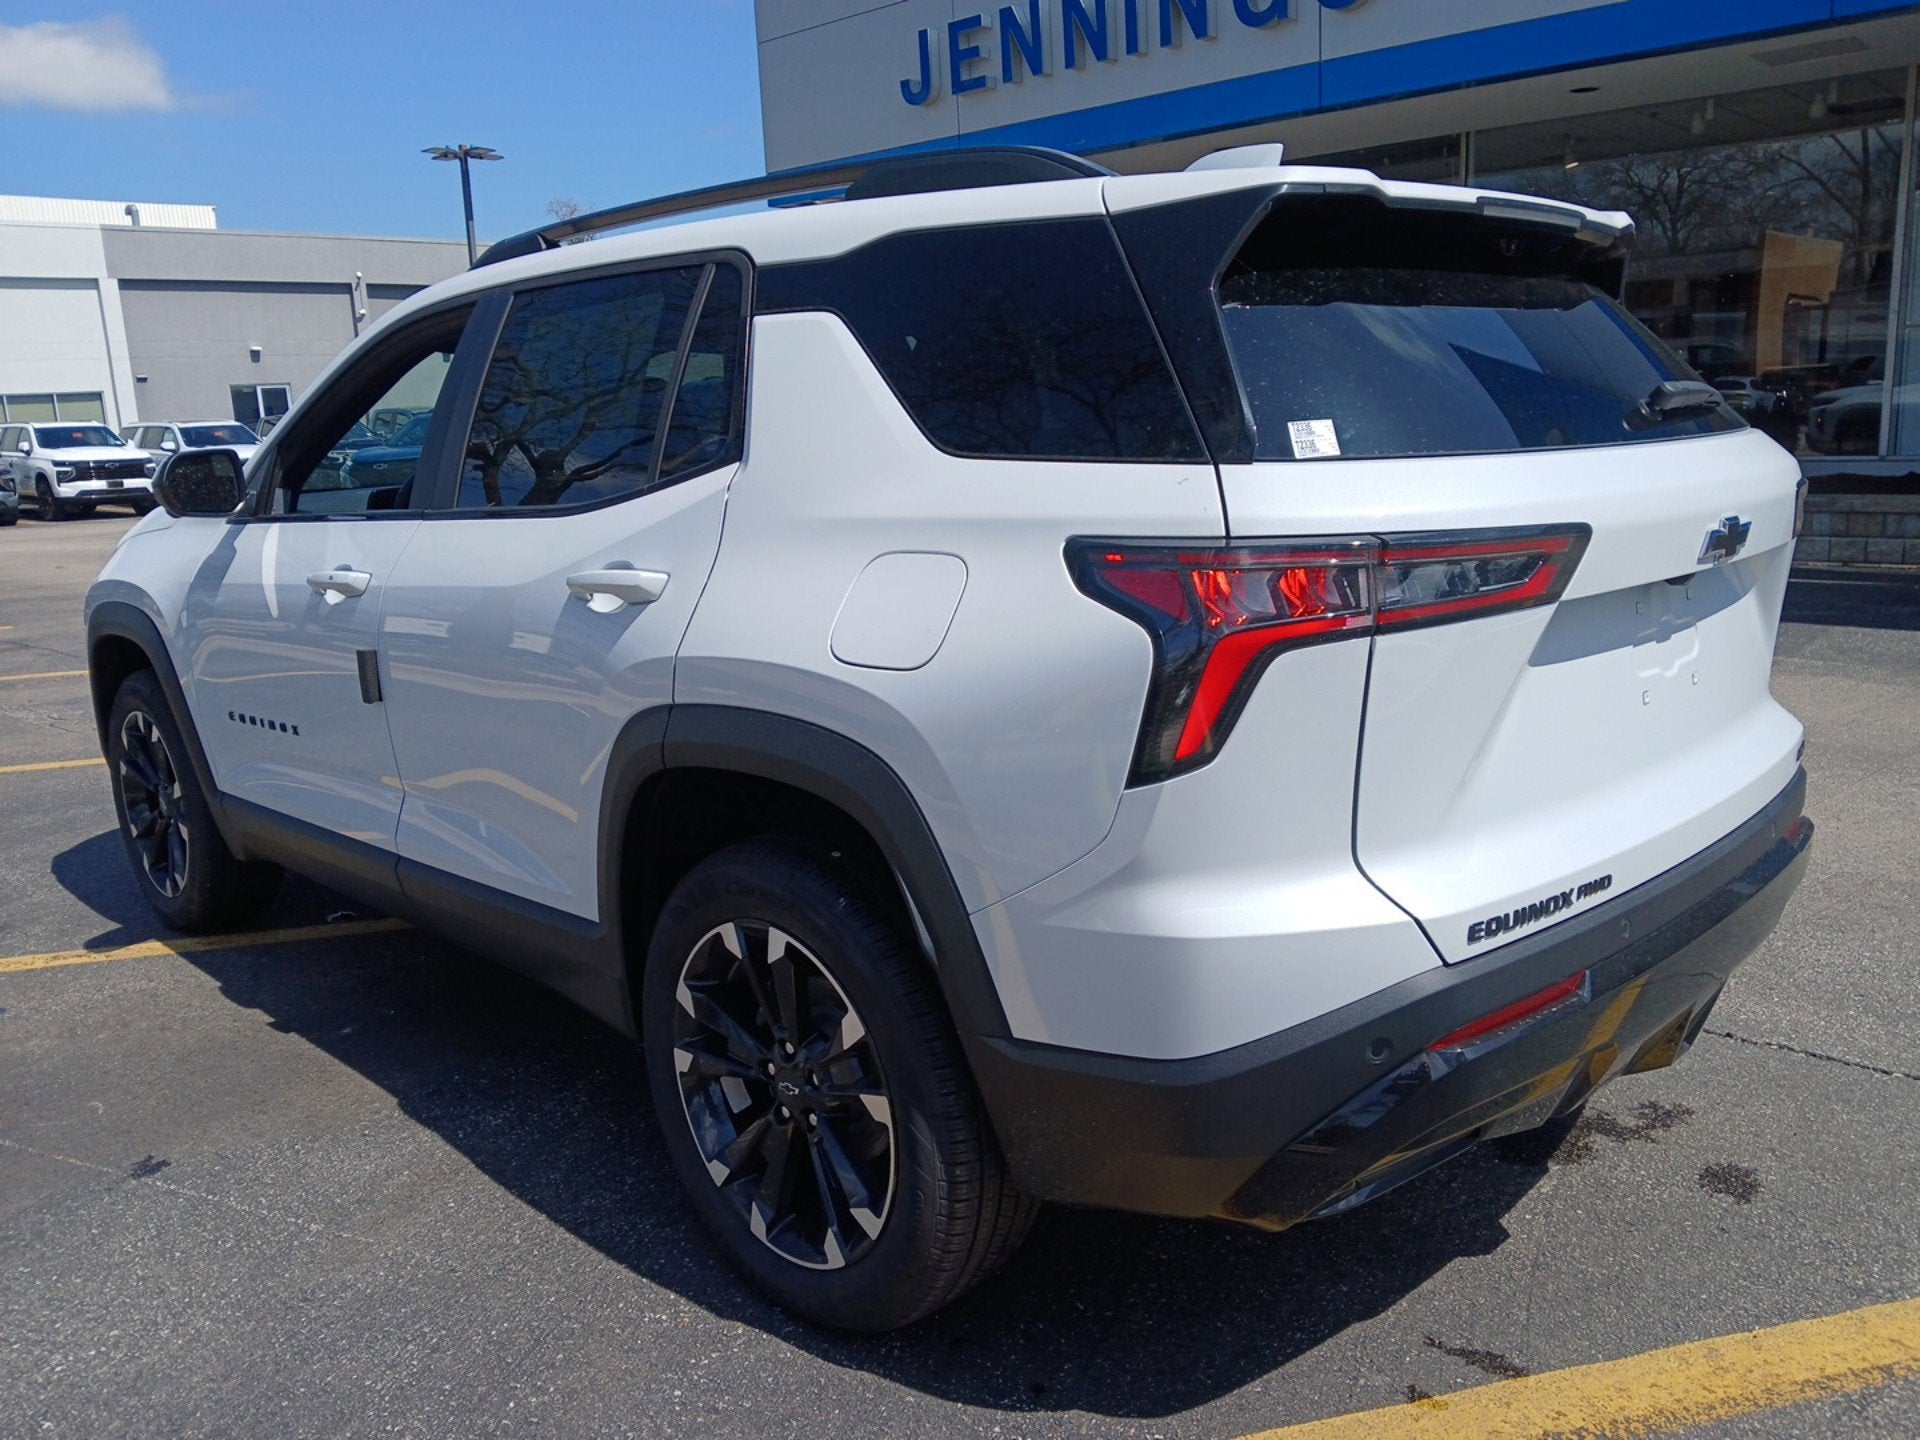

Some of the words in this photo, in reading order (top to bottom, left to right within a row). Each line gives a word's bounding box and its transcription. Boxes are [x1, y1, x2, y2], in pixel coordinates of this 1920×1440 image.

[228, 711, 299, 736] EQUINOX
[1467, 887, 1574, 945] EQUINOX
[1576, 873, 1613, 902] AWD
